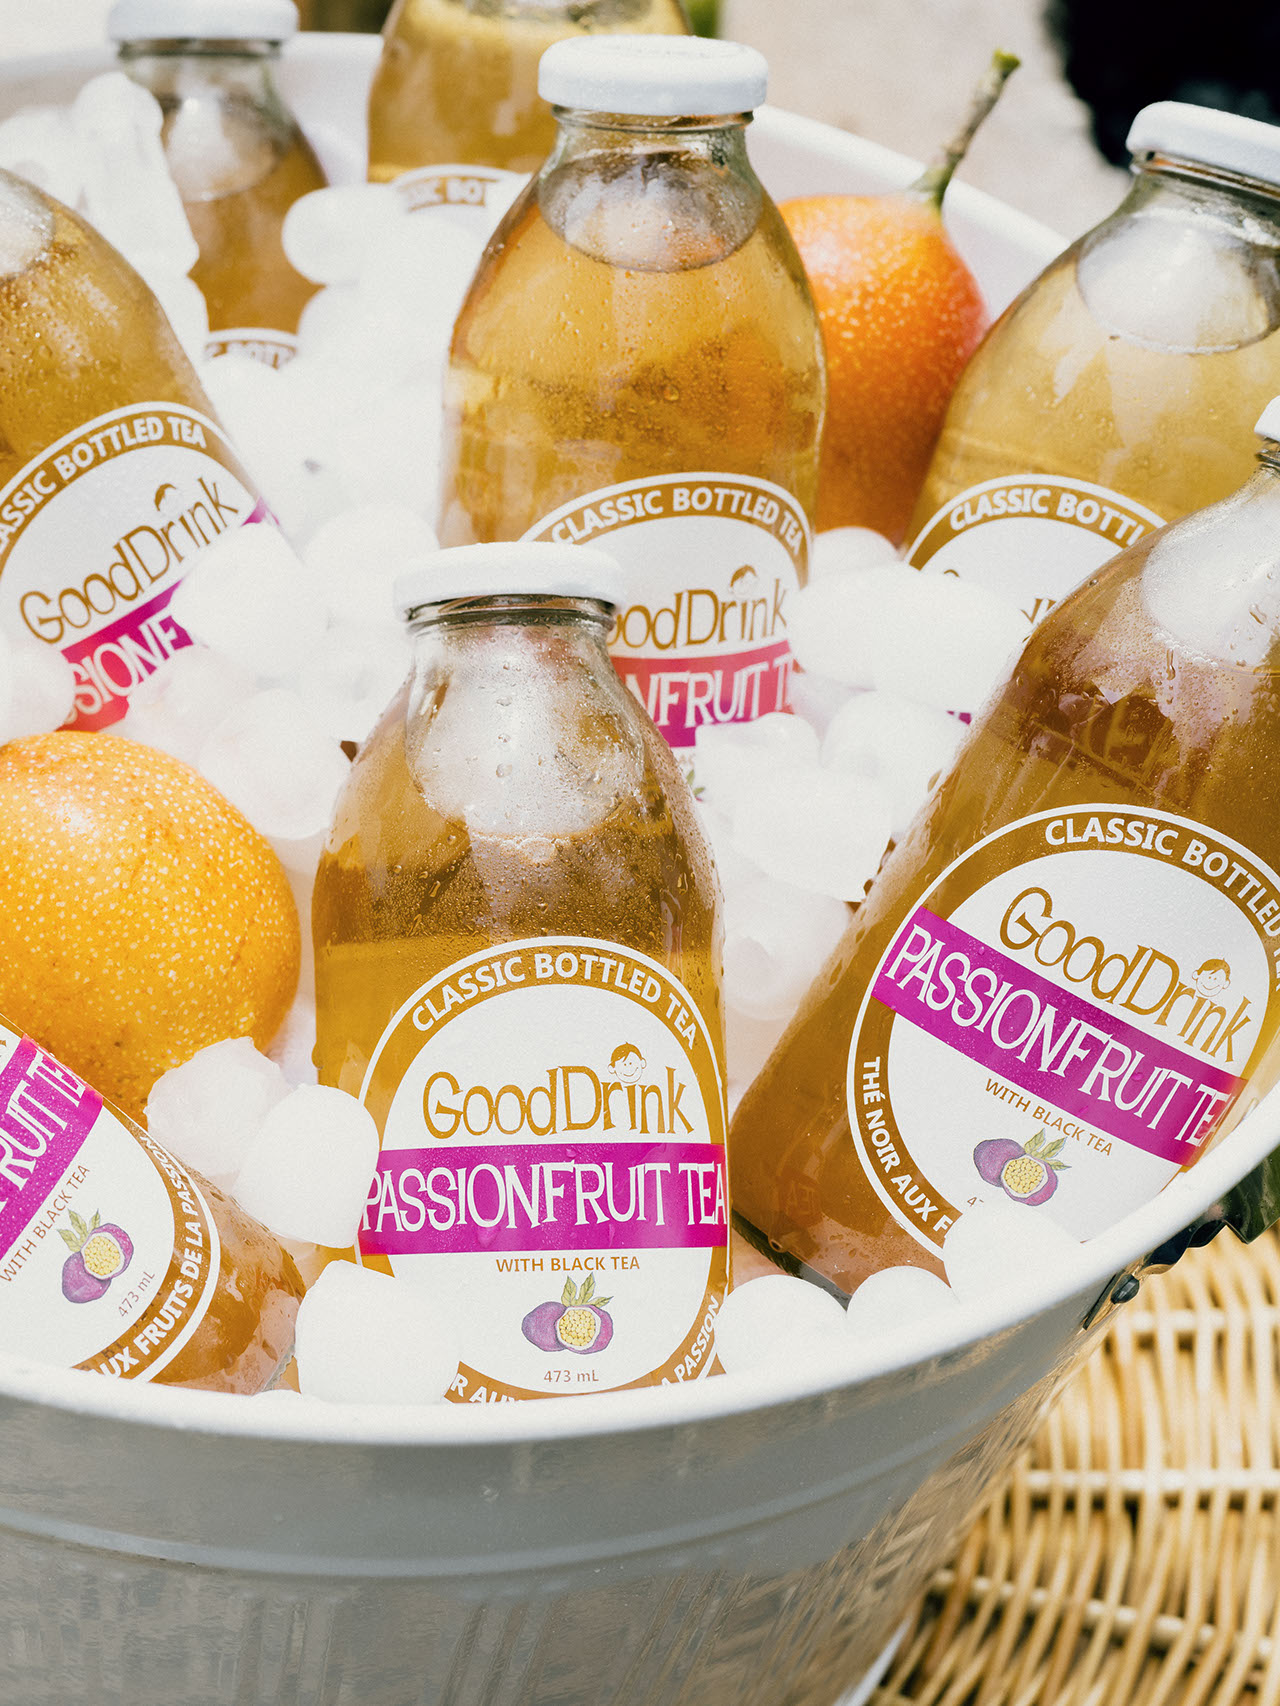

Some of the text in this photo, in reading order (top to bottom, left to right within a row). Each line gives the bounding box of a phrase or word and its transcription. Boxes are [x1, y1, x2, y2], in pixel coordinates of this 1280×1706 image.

[53, 416, 164, 481] BOTTLED
[167, 416, 206, 449] TEA
[552, 487, 804, 556] CLASSIC BOTTLED TEA
[950, 488, 1051, 531] CLASSIC
[20, 477, 239, 645] GoodDrink
[1045, 817, 1179, 856] CLASSIC
[412, 952, 698, 1049] CLASSIC BOTTLED TEA
[1000, 887, 1252, 1063] GoodDrink
[885, 923, 1194, 1130] PASSIONFRUIT
[423, 1065, 695, 1139] GoodDrink
[862, 1056, 938, 1222] THÉ NOIR AUX
[985, 1078, 1114, 1156] WITH BLACK TEA
[140, 1136, 199, 1216] PASSION
[361, 1160, 727, 1233] PASSIONFRUIT TEA
[0, 1165, 90, 1283] WITH BLACK TEA
[184, 1221, 203, 1248] LA
[118, 1271, 156, 1317] 473 mL
[179, 1248, 202, 1281] DE
[496, 1256, 640, 1273] WITH BLACK TEA
[133, 1280, 194, 1356] FRUITS
[673, 1294, 719, 1383] PASSION
[544, 1369, 599, 1383] 473 mL
